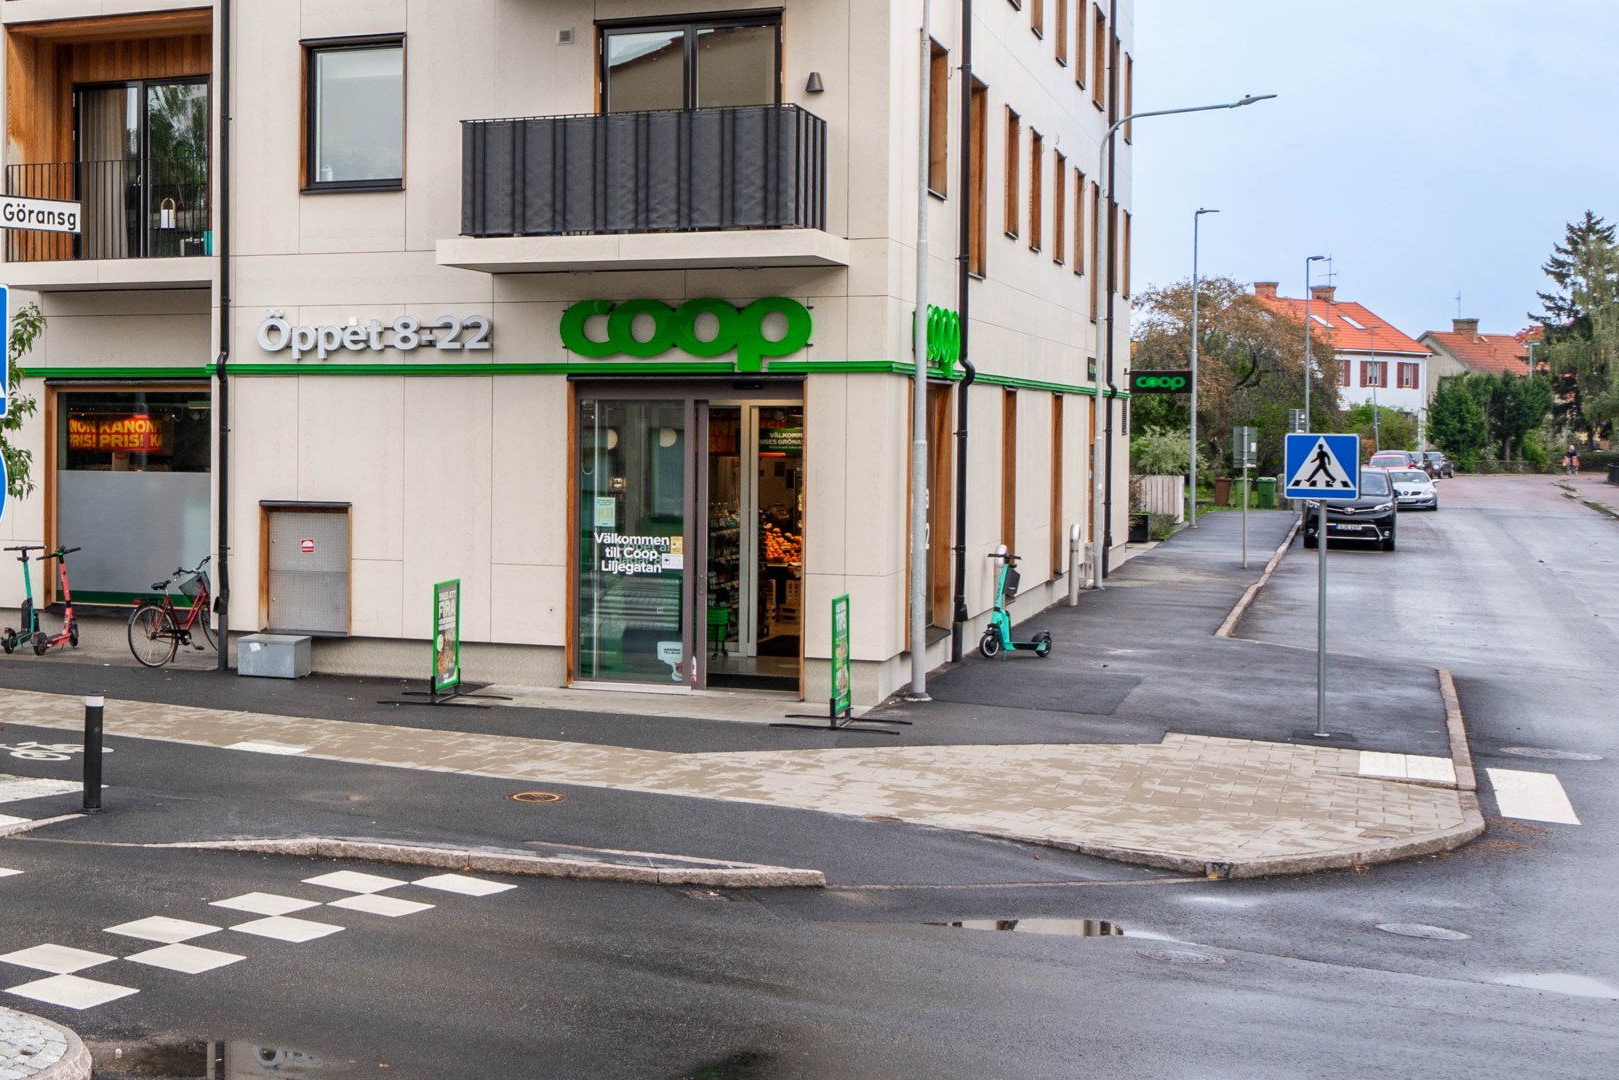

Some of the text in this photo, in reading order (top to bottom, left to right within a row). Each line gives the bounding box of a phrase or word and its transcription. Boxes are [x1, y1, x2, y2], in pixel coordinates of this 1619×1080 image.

[3, 202, 77, 231] Göransg
[257, 309, 492, 360] Öppet 8-22
[560, 296, 812, 372] coop
[1136, 376, 1186, 391] coop
[99, 419, 154, 433] KANON
[99, 433, 144, 448] PRIS!
[594, 532, 670, 545] Välkommen
[605, 546, 658, 561] till Coop
[601, 559, 662, 575] Liljegatan
[439, 600, 455, 618] FIRA
